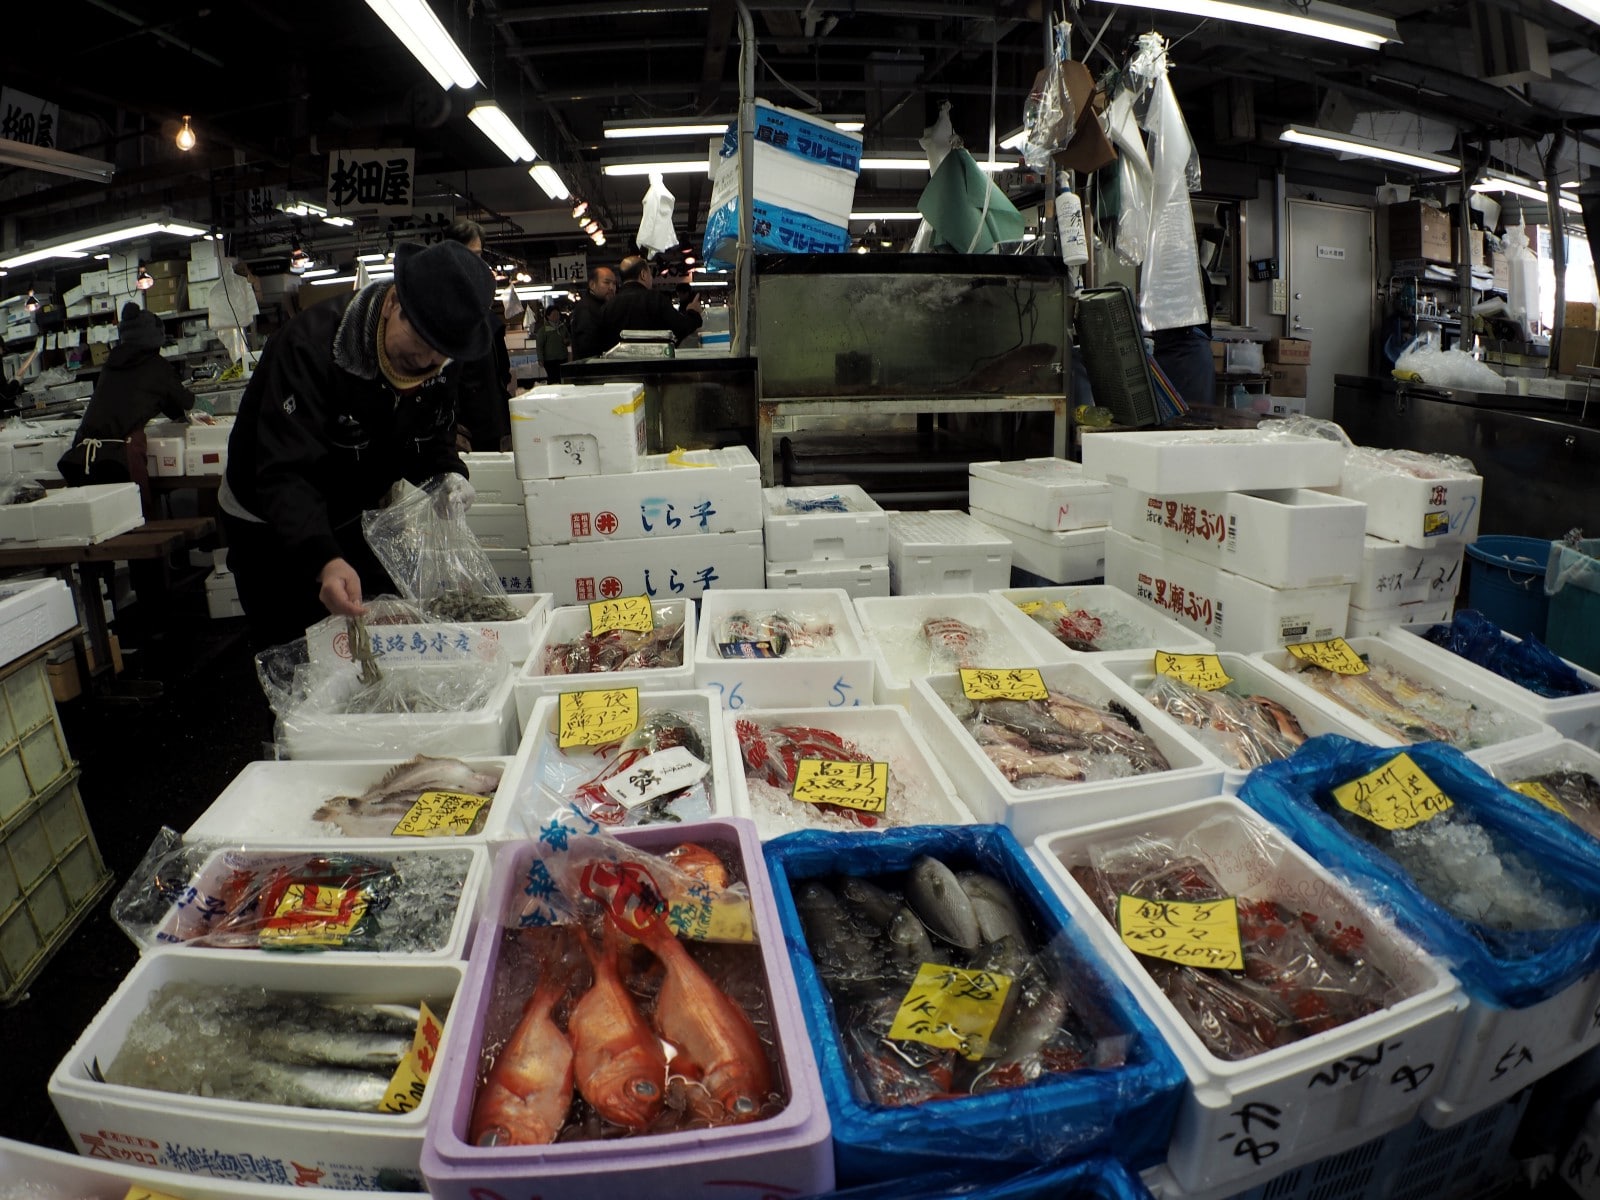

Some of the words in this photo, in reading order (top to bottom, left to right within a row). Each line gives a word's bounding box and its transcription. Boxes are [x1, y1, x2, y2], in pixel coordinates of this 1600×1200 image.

[796, 136, 857, 171] マルヒロ
[328, 158, 411, 207] 杉田屋
[552, 262, 585, 281] 山定
[640, 501, 717, 533] しら子
[1164, 501, 1226, 543] 黒瀬ぶり
[644, 567, 719, 596] しら子
[1153, 578, 1213, 626] 黒瀬ぶり
